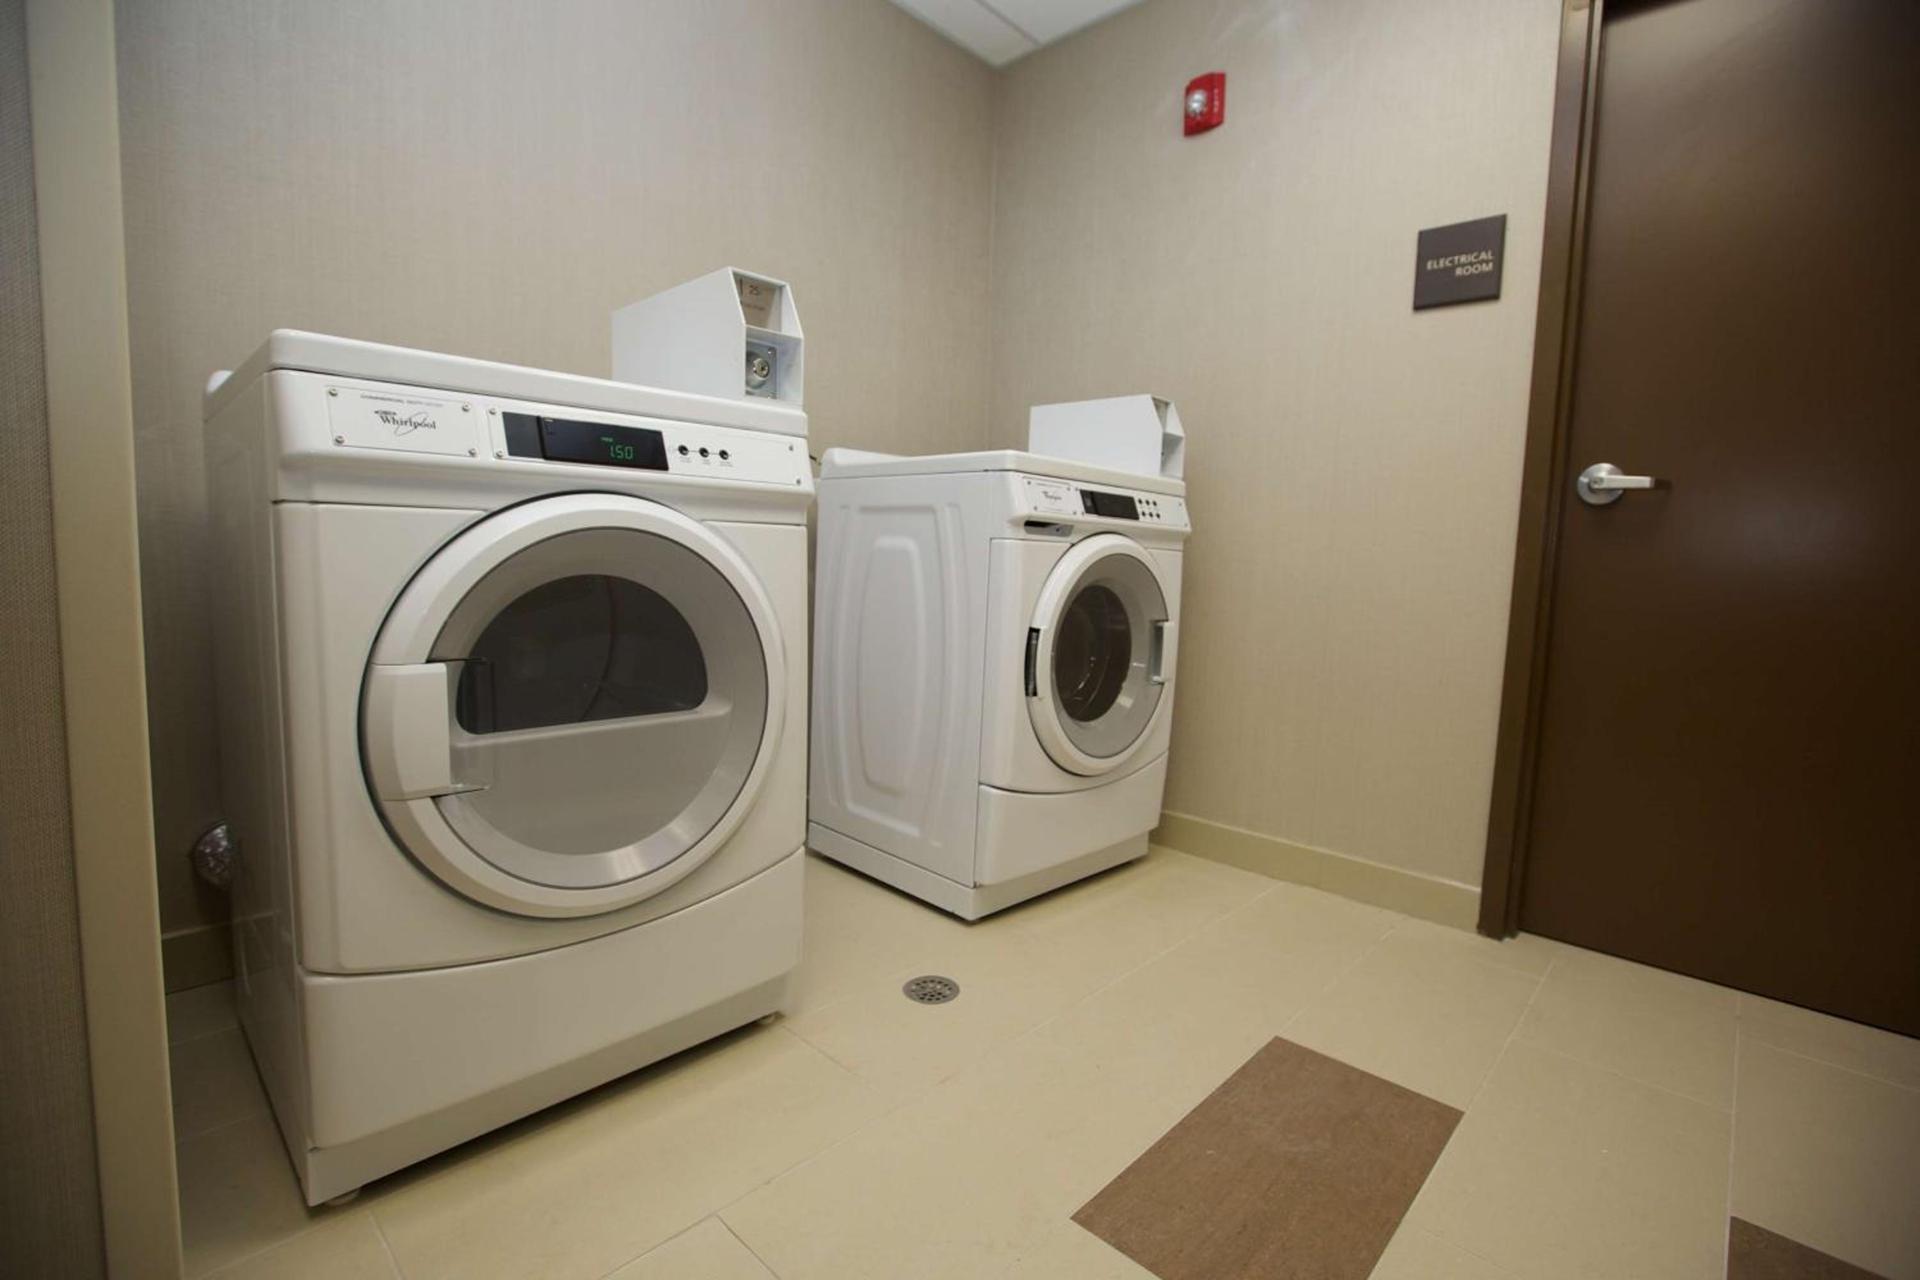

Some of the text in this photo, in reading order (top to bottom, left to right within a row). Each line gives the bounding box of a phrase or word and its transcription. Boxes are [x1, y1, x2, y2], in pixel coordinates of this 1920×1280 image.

[1426, 249, 1494, 271] ELECTRICAL
[1455, 261, 1493, 277] ROOM
[378, 414, 437, 431] Whirlpool
